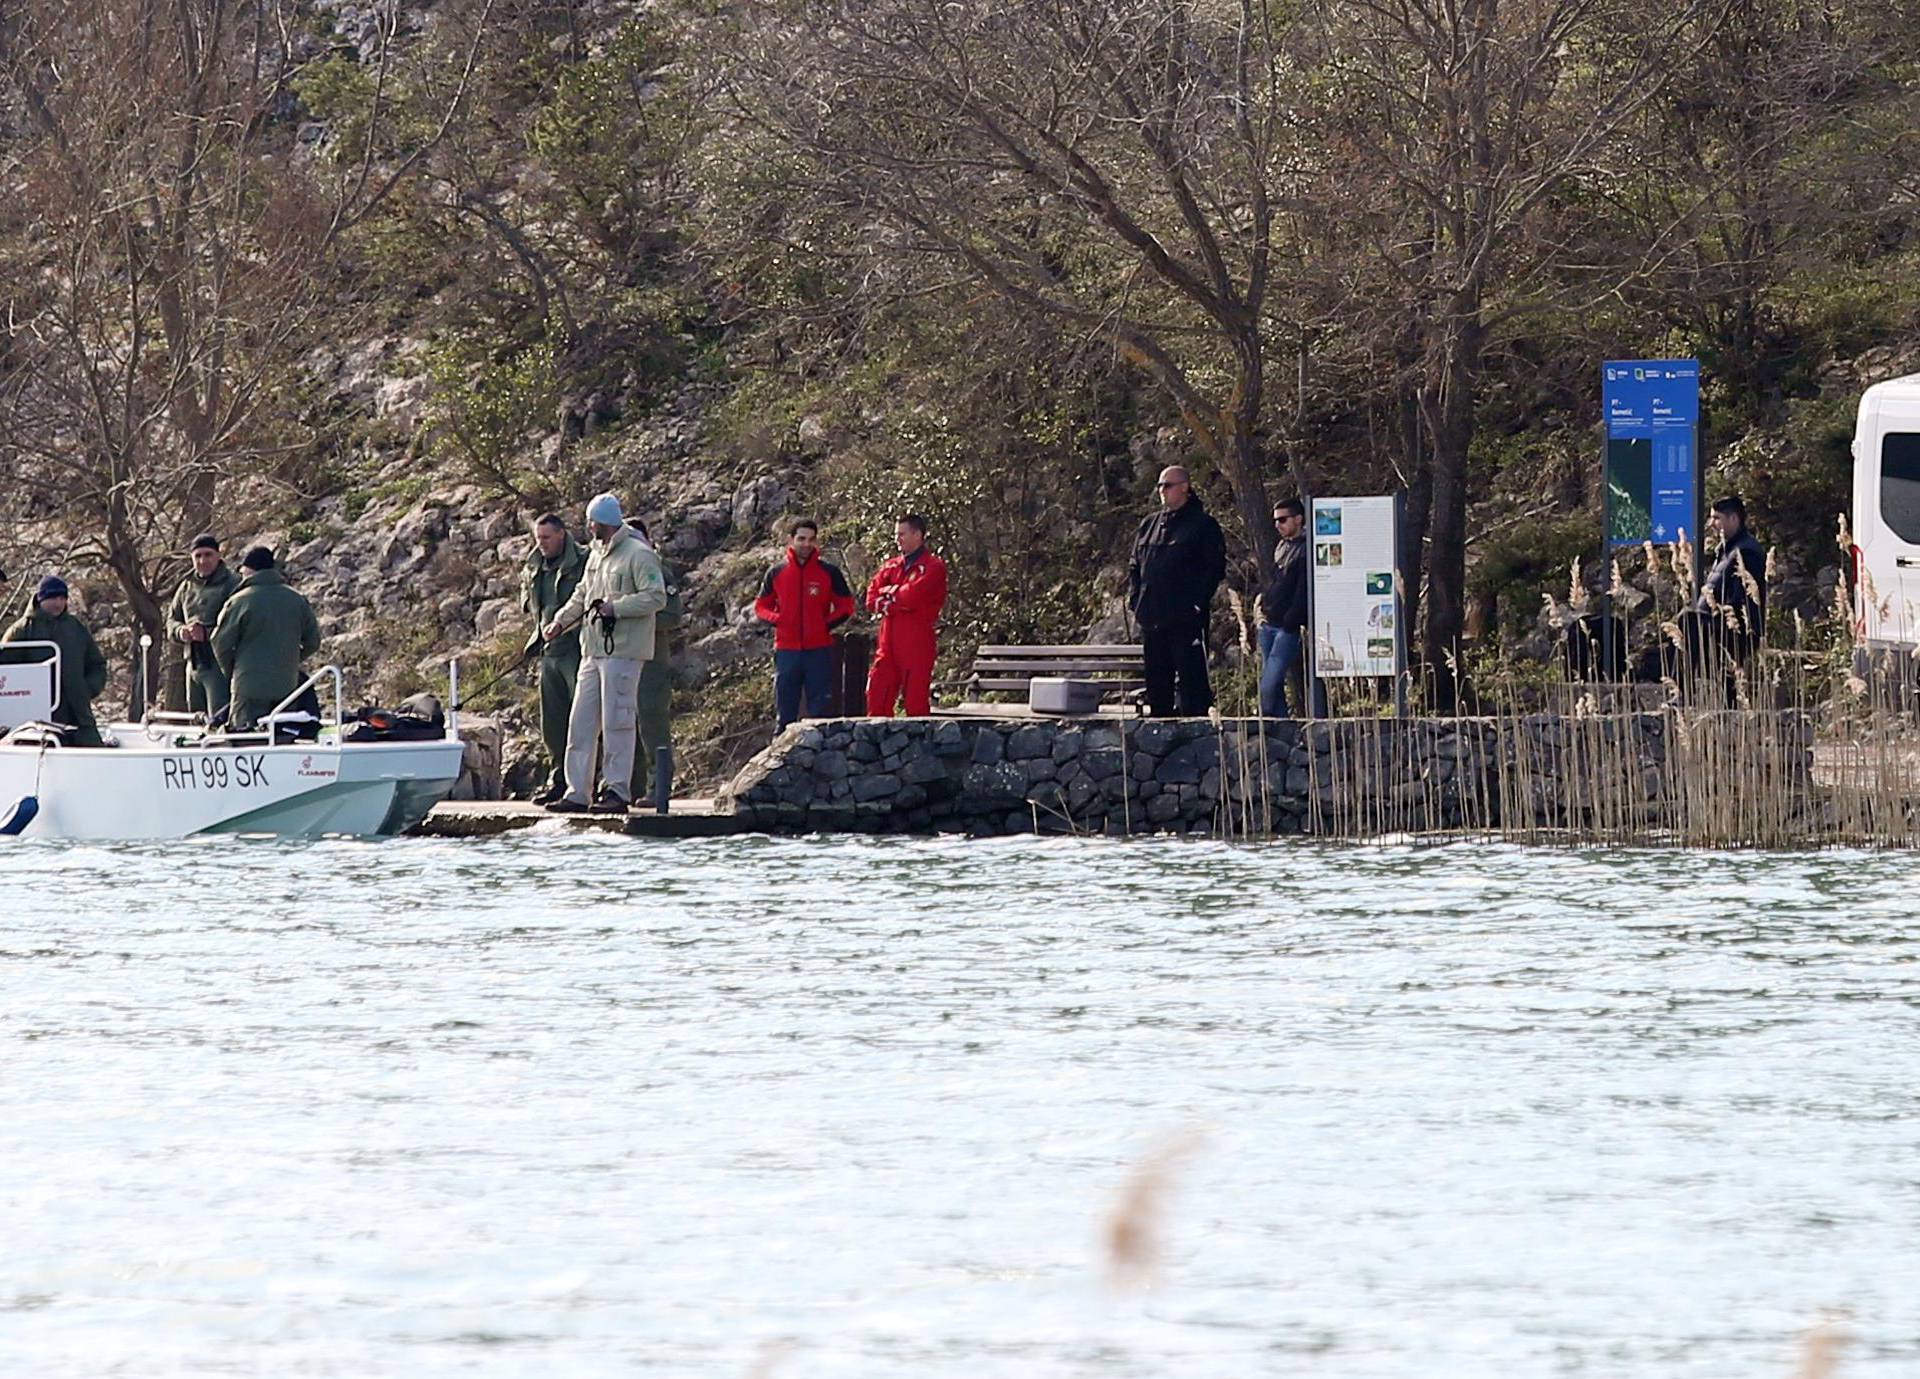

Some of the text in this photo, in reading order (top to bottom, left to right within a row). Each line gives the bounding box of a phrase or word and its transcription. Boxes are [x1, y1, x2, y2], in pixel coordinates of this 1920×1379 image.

[163, 754, 269, 789] RH 99 SK
